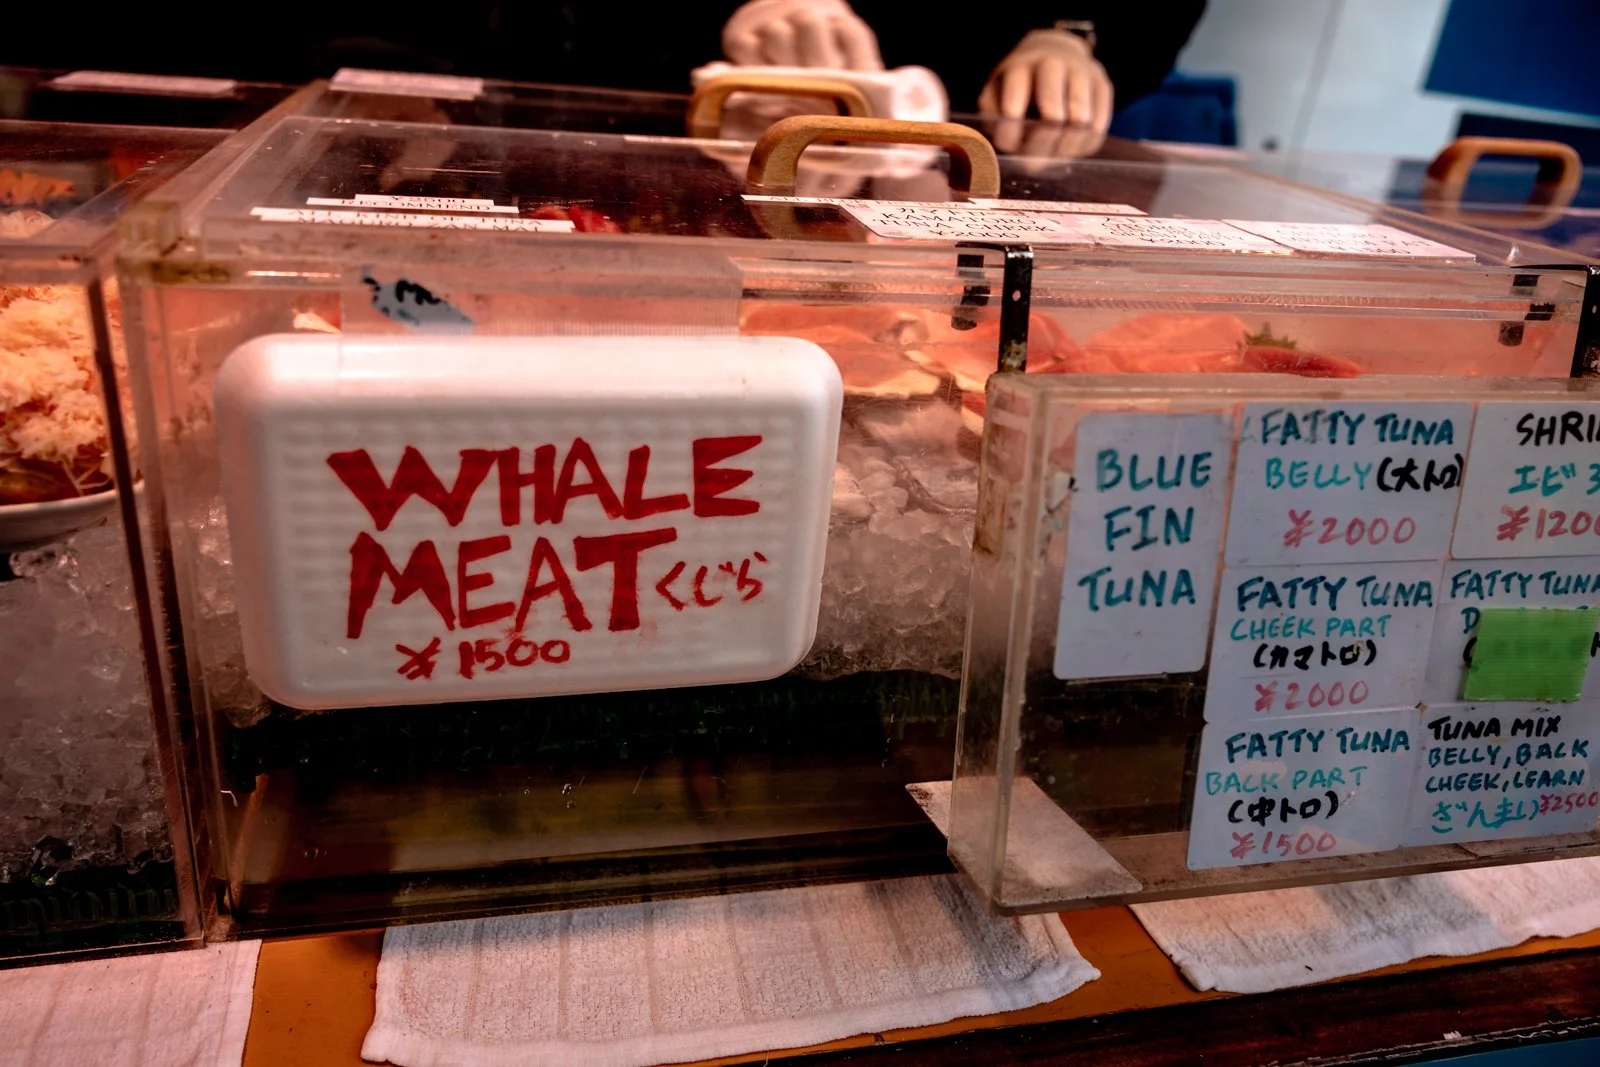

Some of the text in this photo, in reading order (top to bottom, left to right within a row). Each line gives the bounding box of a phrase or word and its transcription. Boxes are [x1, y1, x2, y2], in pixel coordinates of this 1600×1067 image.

[341, 199, 490, 211] RECOMMEND
[357, 211, 417, 220] KIND
[480, 217, 542, 226] TUNA
[882, 213, 1036, 225] KAMATORO
[873, 219, 1056, 232] TUNA CHEEK
[1261, 408, 1454, 446] FATTY TUNA
[1516, 411, 1600, 446] SHRI
[326, 436, 762, 531] WHALE
[1097, 448, 1213, 492] BLUE
[1265, 457, 1373, 491] BELLY
[1508, 462, 1577, 497] エビ
[1104, 504, 1195, 552] FIN
[346, 527, 768, 638] MEAT くじら
[1078, 566, 1196, 612] TUNA
[1237, 575, 1434, 612] FATTY TUNA
[1450, 569, 1533, 600] FATTY
[1230, 614, 1392, 641] CHEEK PART
[1225, 727, 1410, 763] FATTY TUNA
[1428, 715, 1561, 742] TUNA MIX
[1204, 765, 1367, 796] BACK PART
